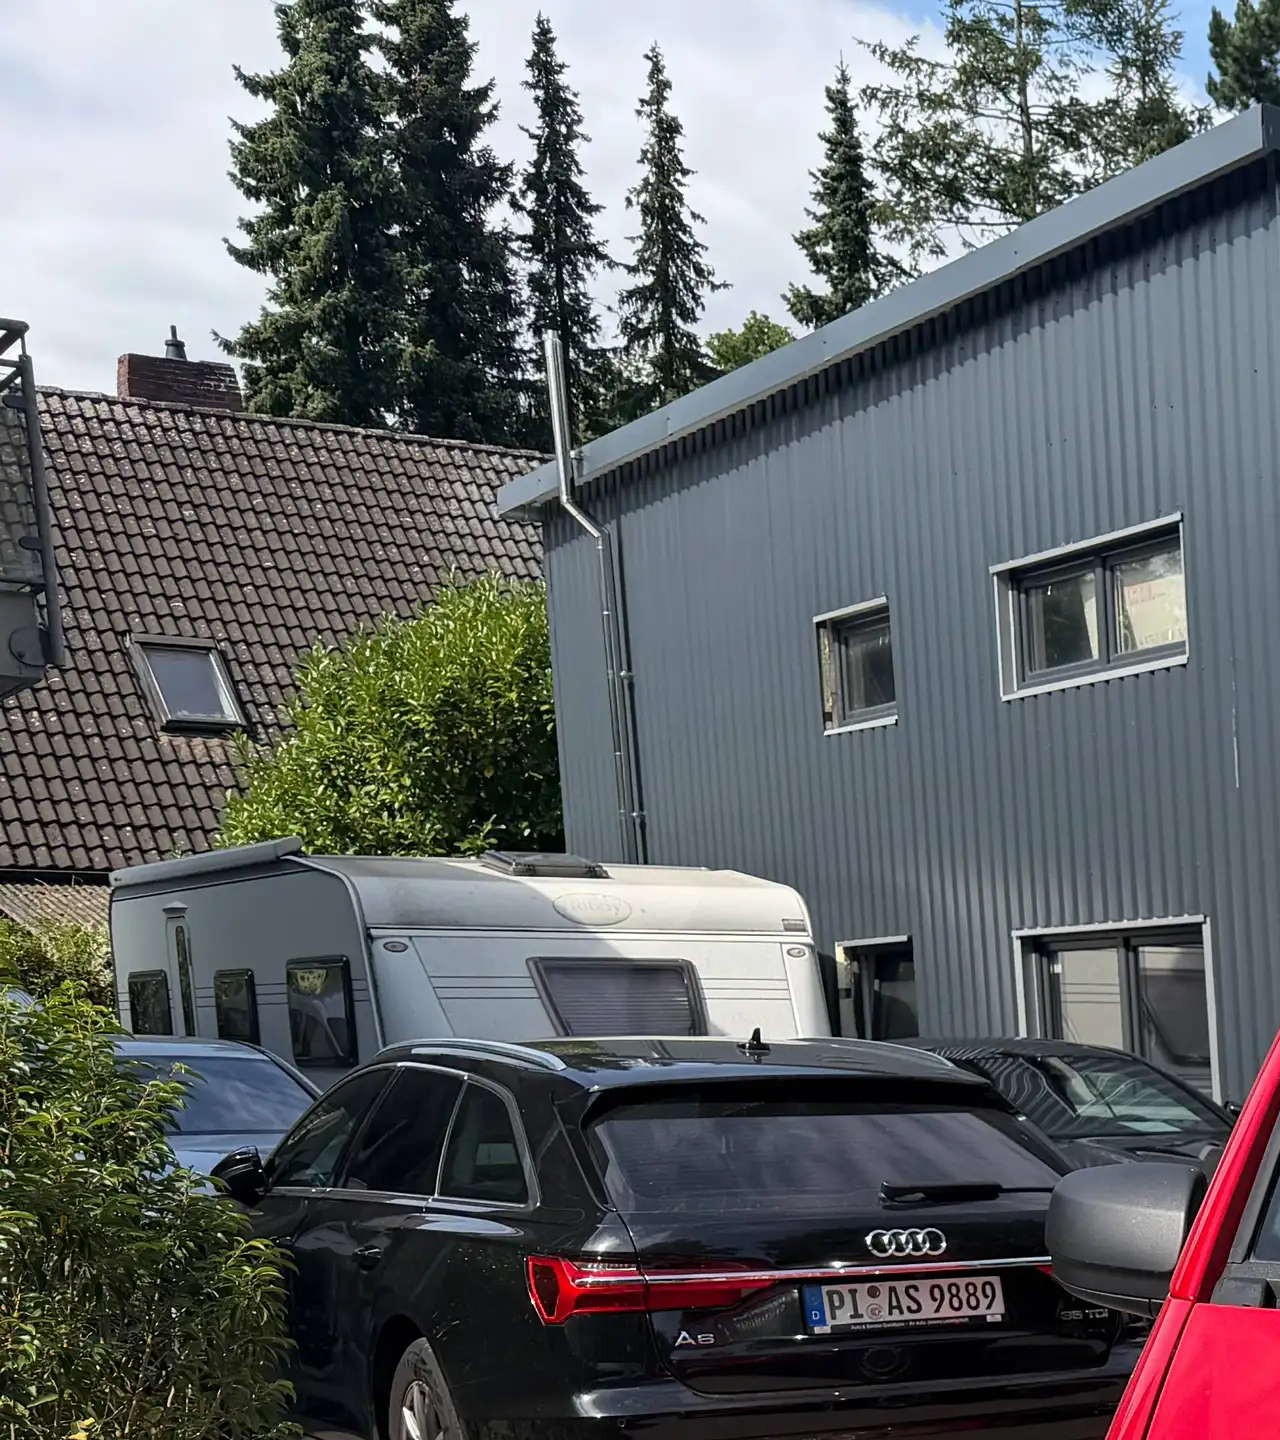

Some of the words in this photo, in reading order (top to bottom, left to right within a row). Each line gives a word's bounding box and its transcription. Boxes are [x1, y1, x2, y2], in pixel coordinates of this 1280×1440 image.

[825, 1288, 864, 1320] PI
[887, 1284, 923, 1315] AS
[929, 1280, 997, 1313] 9889
[811, 1311, 820, 1320] D
[1060, 1310, 1083, 1320] 35
[1085, 1308, 1109, 1319] TDI
[674, 1330, 716, 1347] A6
